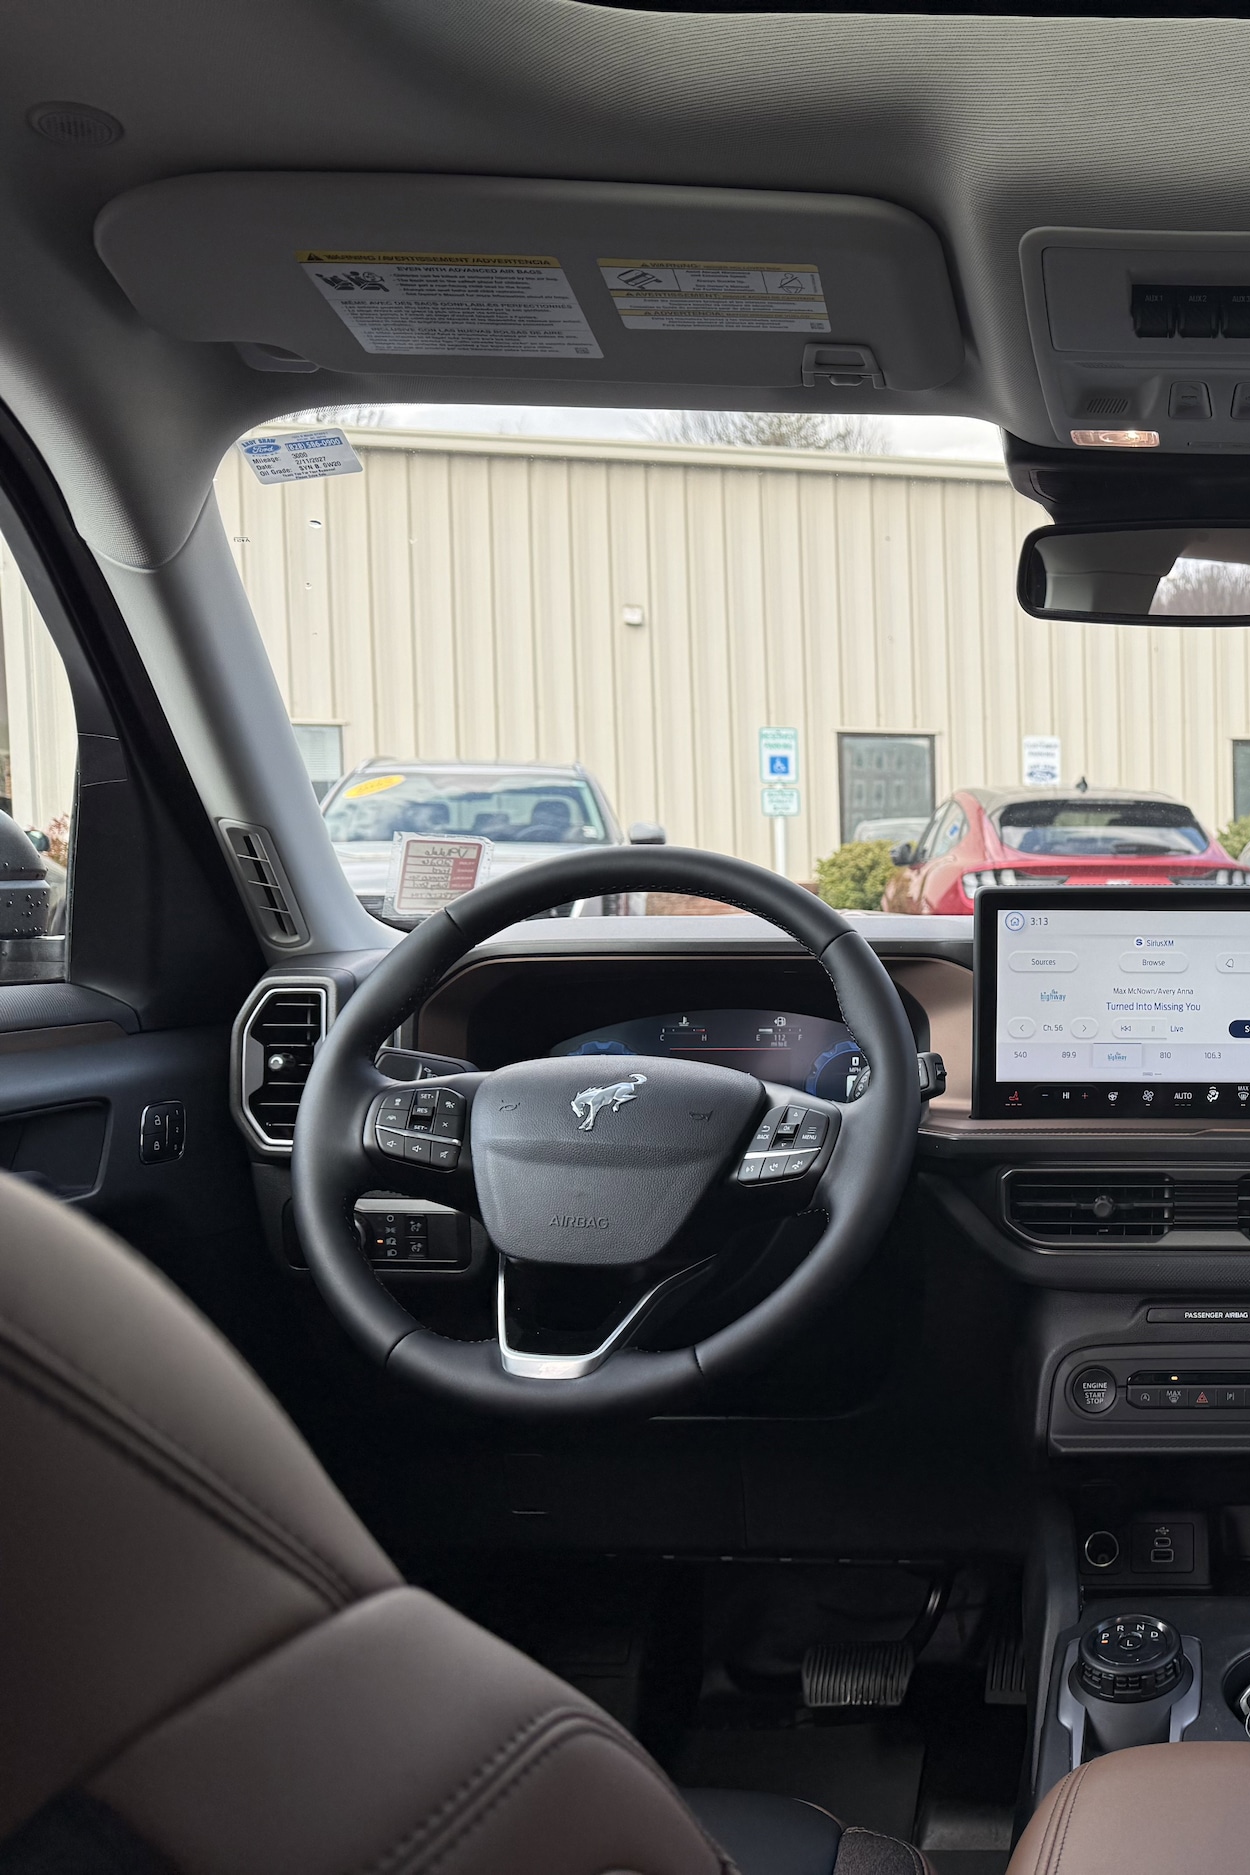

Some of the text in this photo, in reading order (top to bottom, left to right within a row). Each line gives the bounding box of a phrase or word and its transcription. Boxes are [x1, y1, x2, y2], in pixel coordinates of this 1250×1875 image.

[251, 445, 274, 454] Ford
[1030, 917, 1049, 926] 3:13
[1146, 939, 1174, 947] SiriusXM
[1031, 958, 1056, 966] Sources
[1142, 958, 1165, 967] Browse
[1112, 987, 1127, 996] Max
[1176, 987, 1194, 996] Anna
[1106, 1002, 1201, 1013] Turned Into Missing You
[1043, 1024, 1064, 1032] Ch. 56
[1170, 1024, 1184, 1033] Live
[660, 1034, 665, 1042] C
[702, 1034, 707, 1042] H
[756, 1034, 761, 1042] E
[774, 1034, 787, 1042] 112
[798, 1034, 803, 1042] F
[1013, 1051, 1028, 1059] 540
[1061, 1051, 1077, 1059] 89.9
[1159, 1051, 1172, 1059] 810
[1204, 1051, 1222, 1059] 106.3
[852, 1056, 860, 1066] 0
[1062, 1091, 1070, 1100] HI
[1173, 1091, 1192, 1100] AUTO
[802, 1133, 817, 1141] MENU
[549, 1214, 610, 1230] AIRBAG
[1184, 1311, 1249, 1319] PASSENGER AIRBAG
[1082, 1381, 1108, 1389] ENGINE
[1084, 1391, 1105, 1399] START
[1101, 1632, 1110, 1640] P
